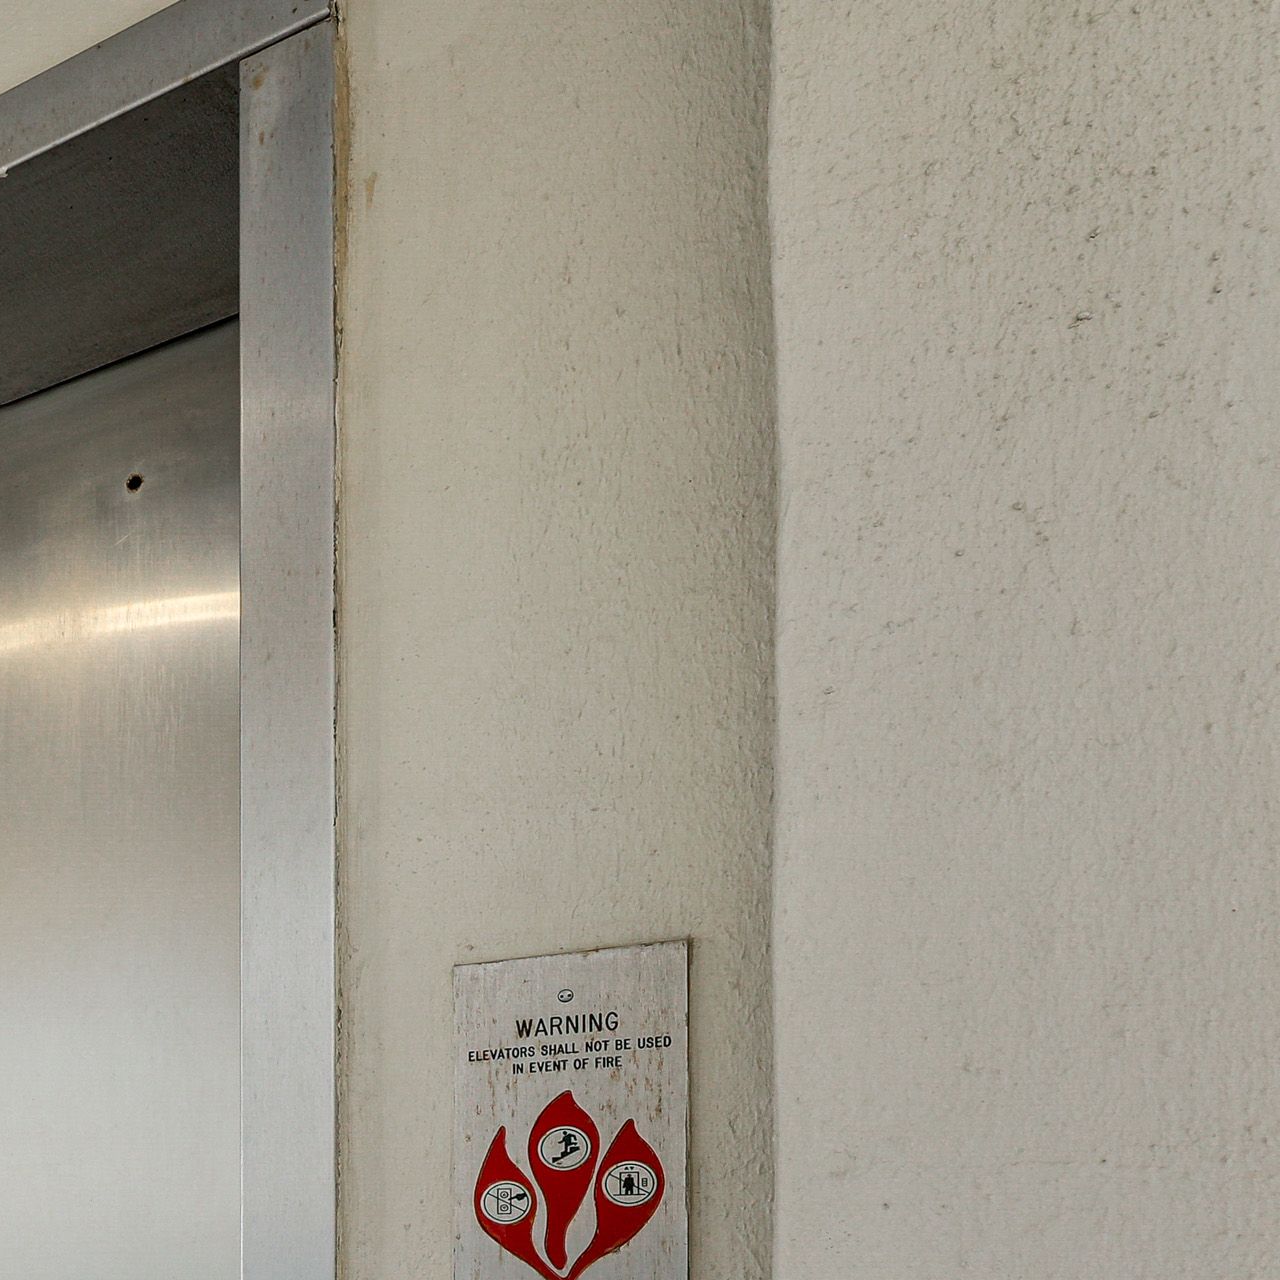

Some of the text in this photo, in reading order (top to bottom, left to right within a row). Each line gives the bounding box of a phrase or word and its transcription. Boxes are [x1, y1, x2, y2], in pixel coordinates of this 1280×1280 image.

[515, 1011, 619, 1038] WARNING
[468, 1035, 672, 1062] ELEVATORS SHALL NOT BE USED
[512, 1056, 622, 1075] IN EVENT OF FIRE
